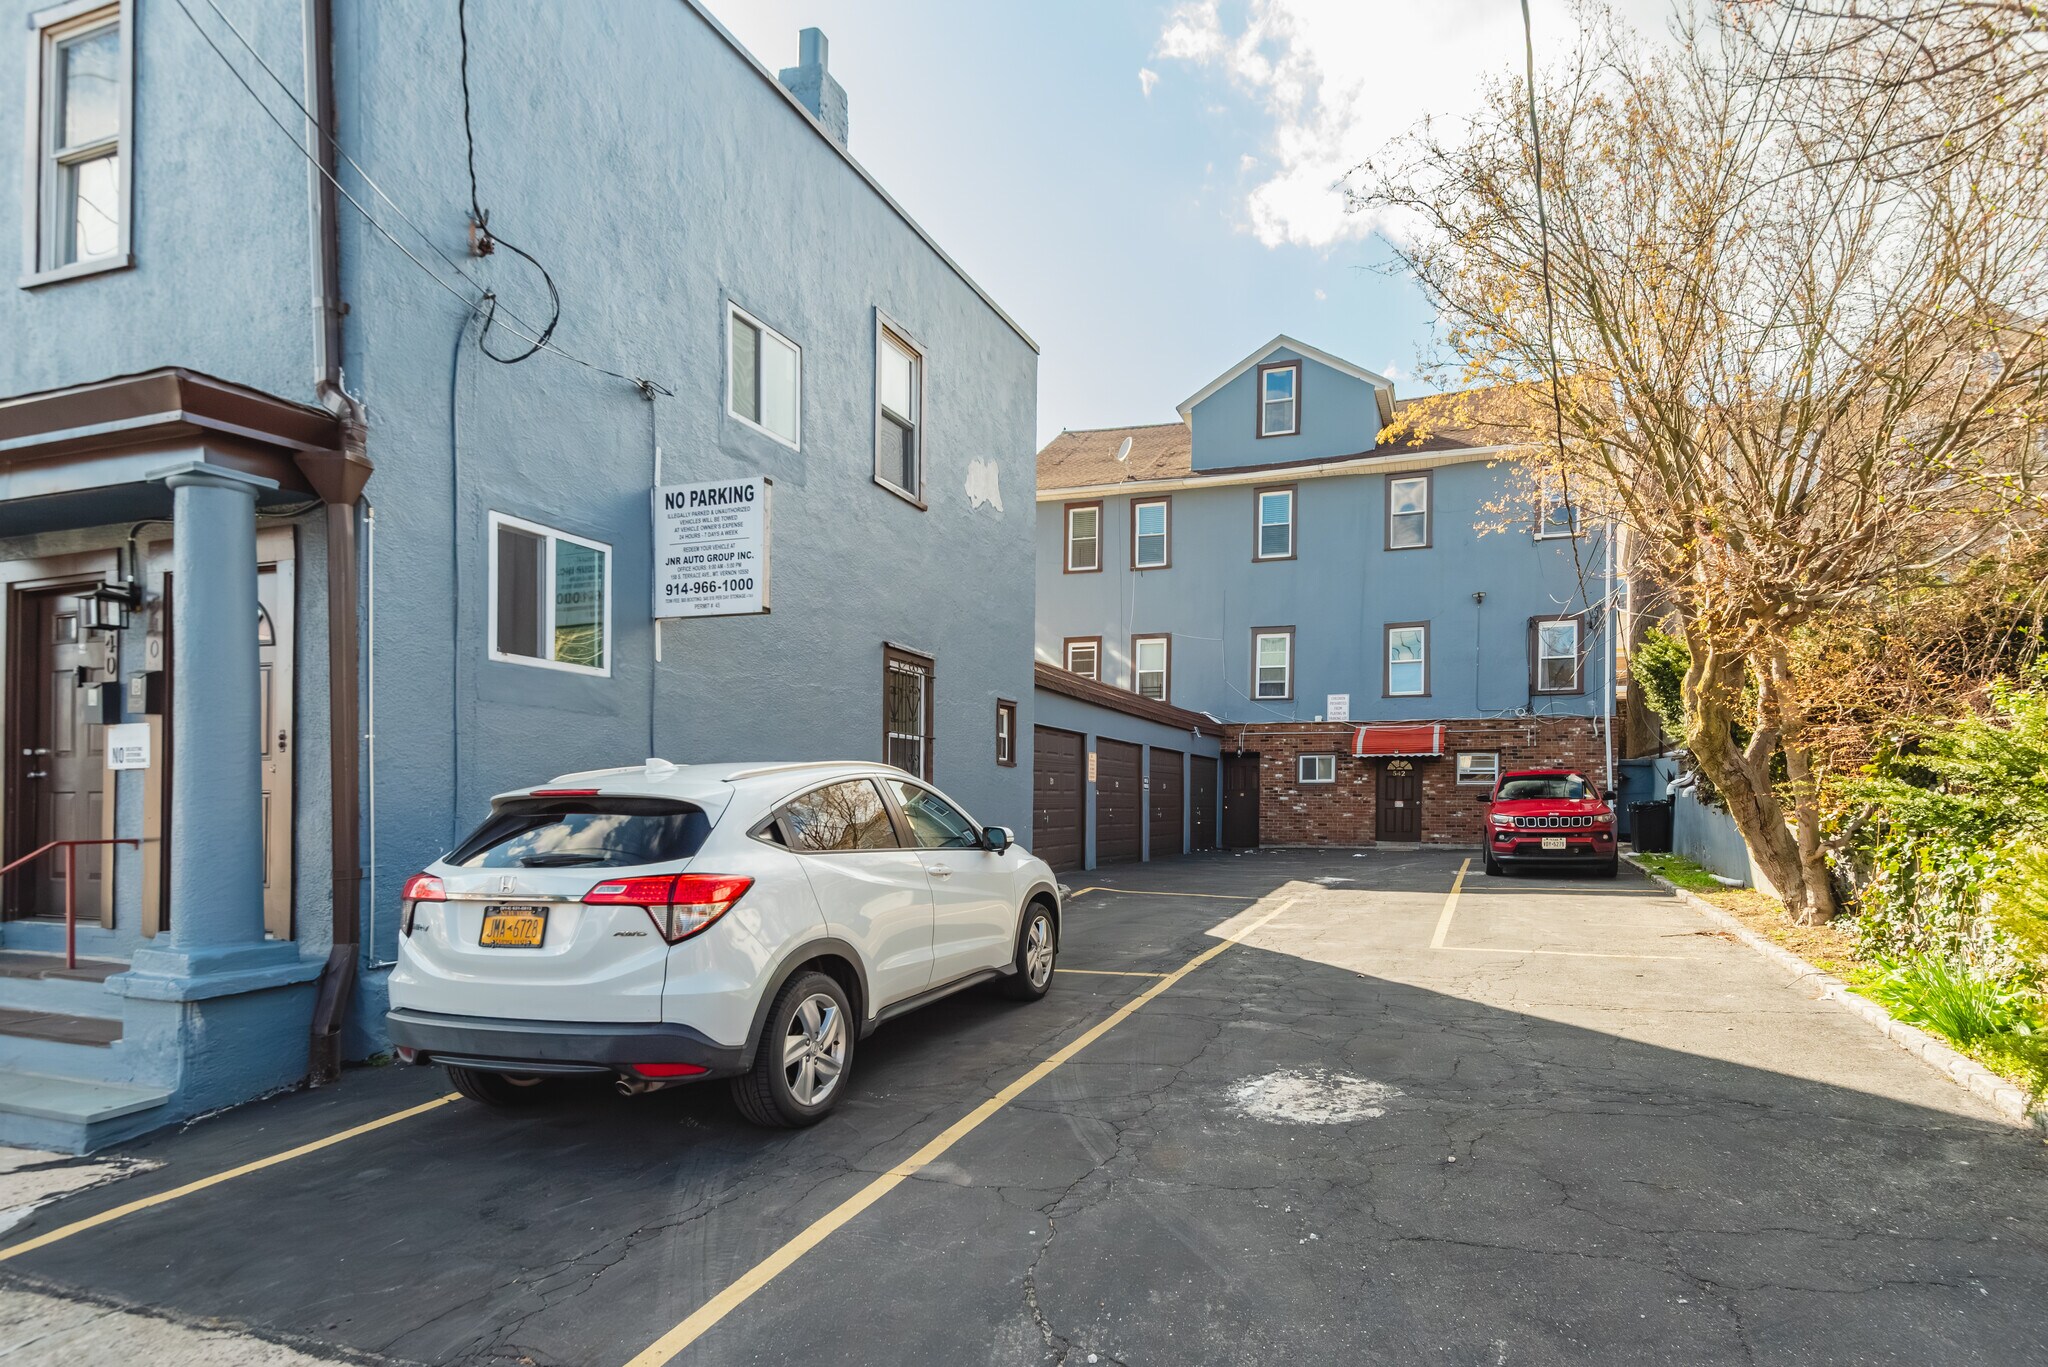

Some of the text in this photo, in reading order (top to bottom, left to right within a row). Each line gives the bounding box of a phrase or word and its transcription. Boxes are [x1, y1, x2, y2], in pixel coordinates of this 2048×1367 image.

[665, 484, 754, 510] NO PARKING
[715, 506, 751, 514] UNAUTHORIZED
[665, 550, 754, 566] JNR AUTO GROUP INC.
[666, 578, 753, 595] 914-966-1000
